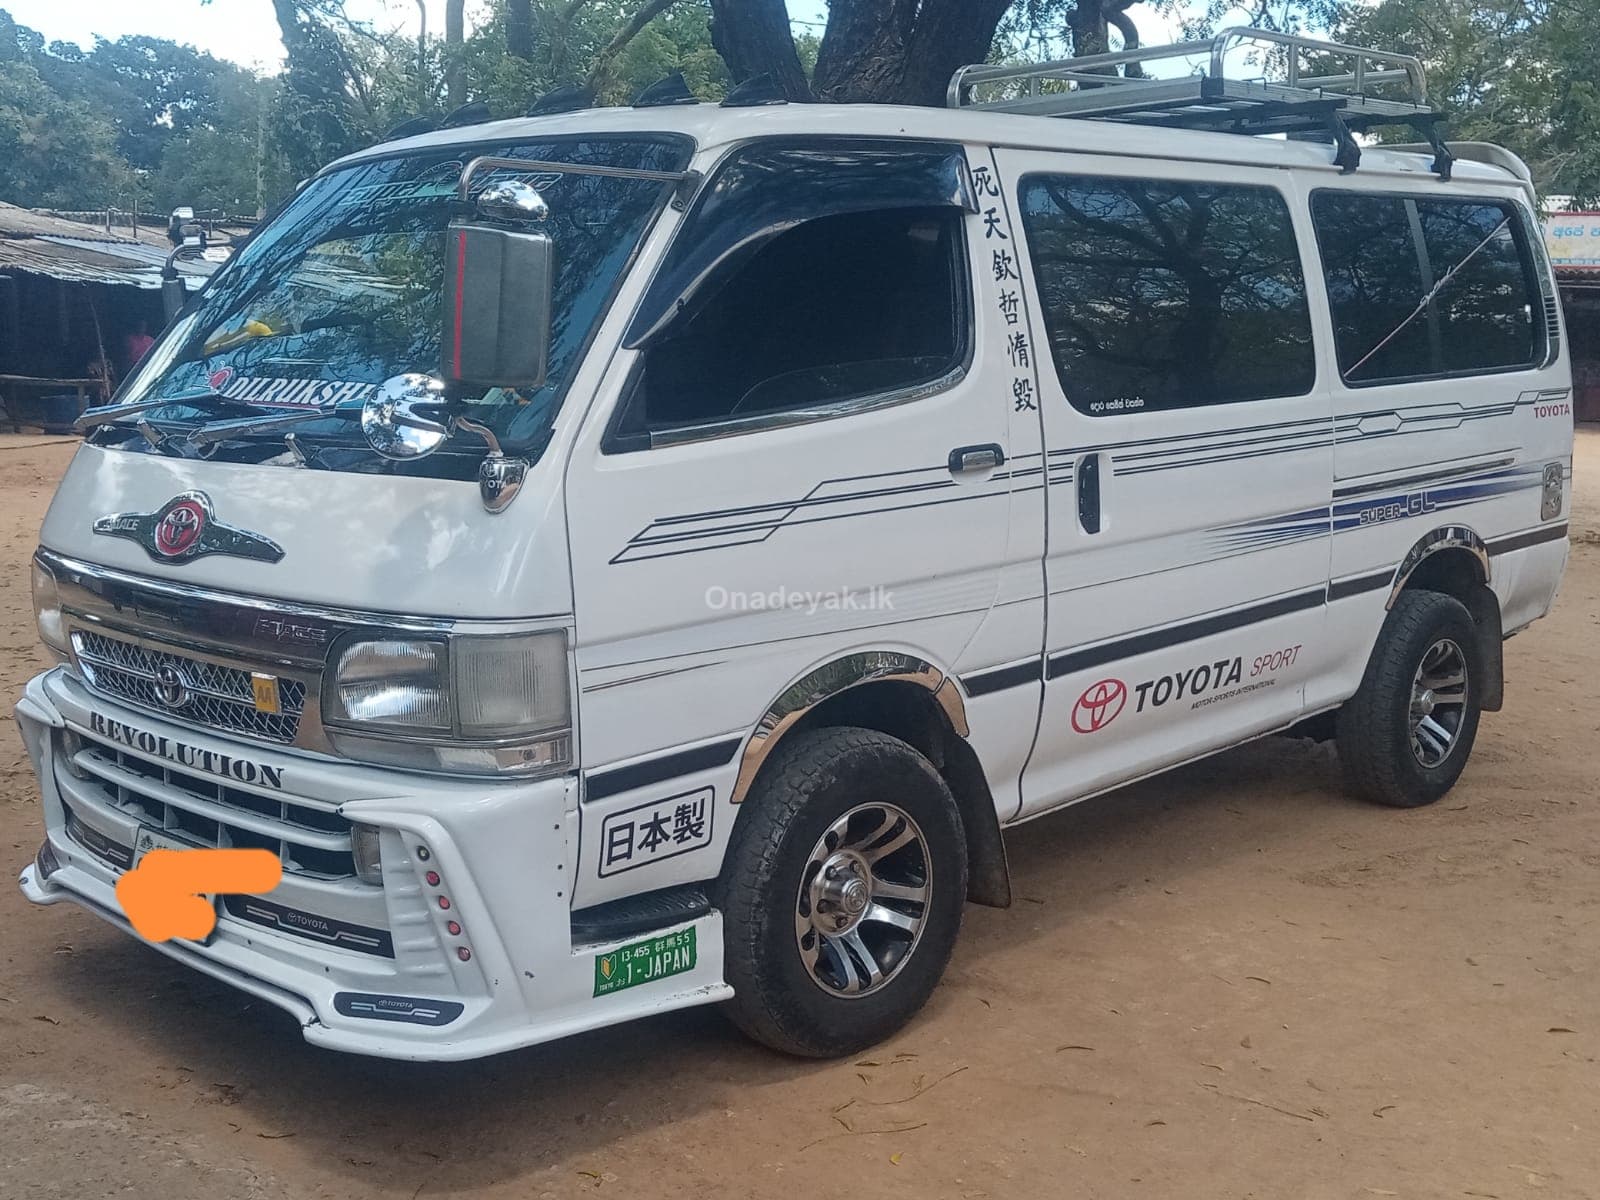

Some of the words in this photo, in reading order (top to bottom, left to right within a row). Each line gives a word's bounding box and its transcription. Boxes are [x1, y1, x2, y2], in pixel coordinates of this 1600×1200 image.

[1534, 404, 1570, 418] TOYOTA
[1360, 503, 1400, 525] SUPER
[1407, 490, 1436, 516] GL
[1135, 656, 1242, 713] TOYOTA
[1250, 645, 1302, 677] SPORT
[90, 711, 285, 788] REVOLUTION
[606, 797, 706, 866] 日本製
[297, 915, 329, 930] TOYOTA
